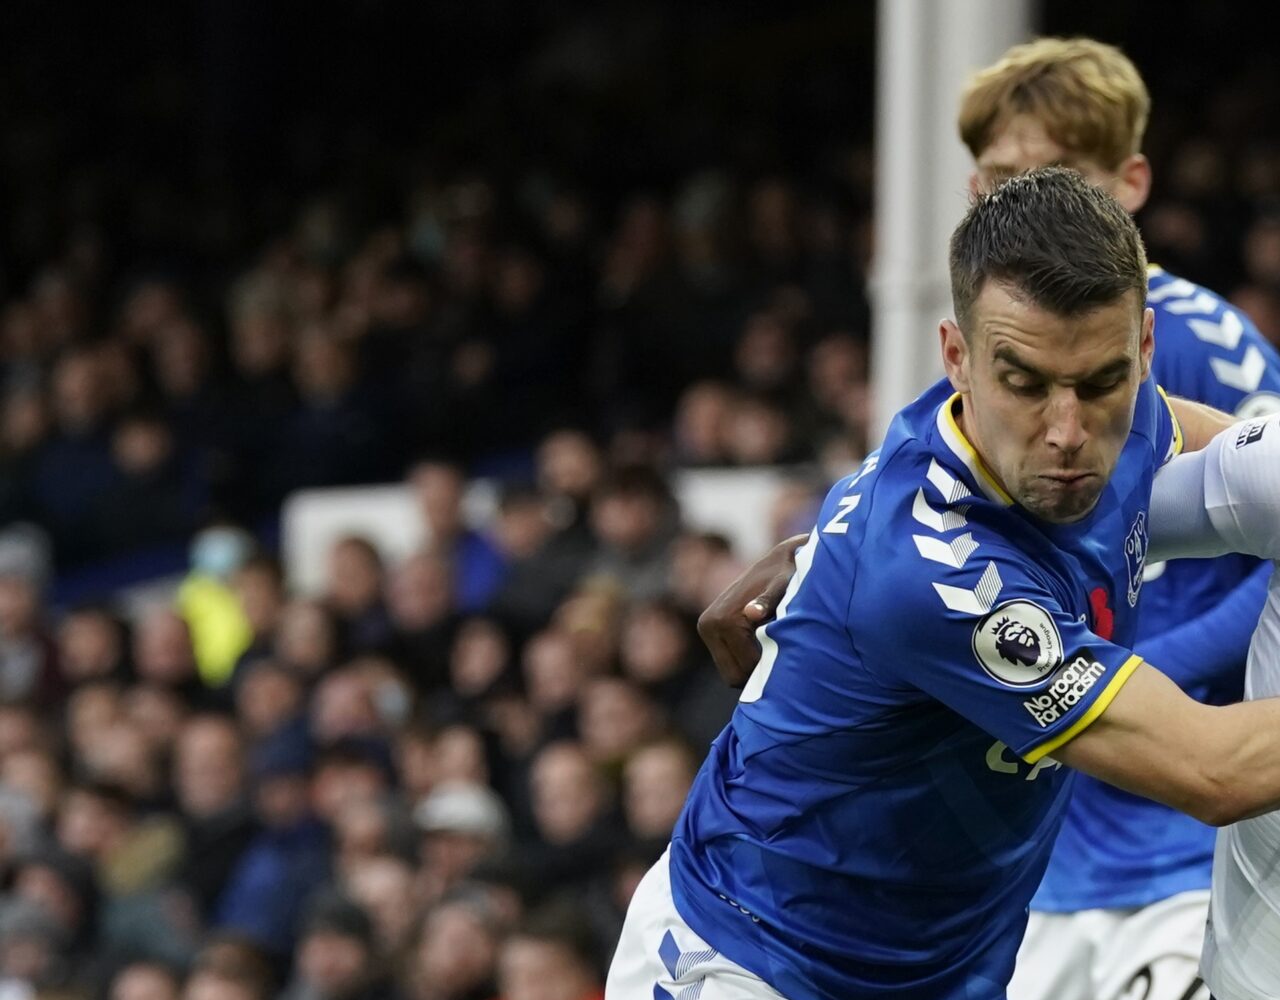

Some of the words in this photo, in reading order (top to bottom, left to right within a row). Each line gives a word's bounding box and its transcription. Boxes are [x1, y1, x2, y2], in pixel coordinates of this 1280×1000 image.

[1023, 695, 1052, 716] No
[1048, 656, 1089, 700] room
[1034, 706, 1062, 728] for
[1058, 661, 1107, 711] racism
